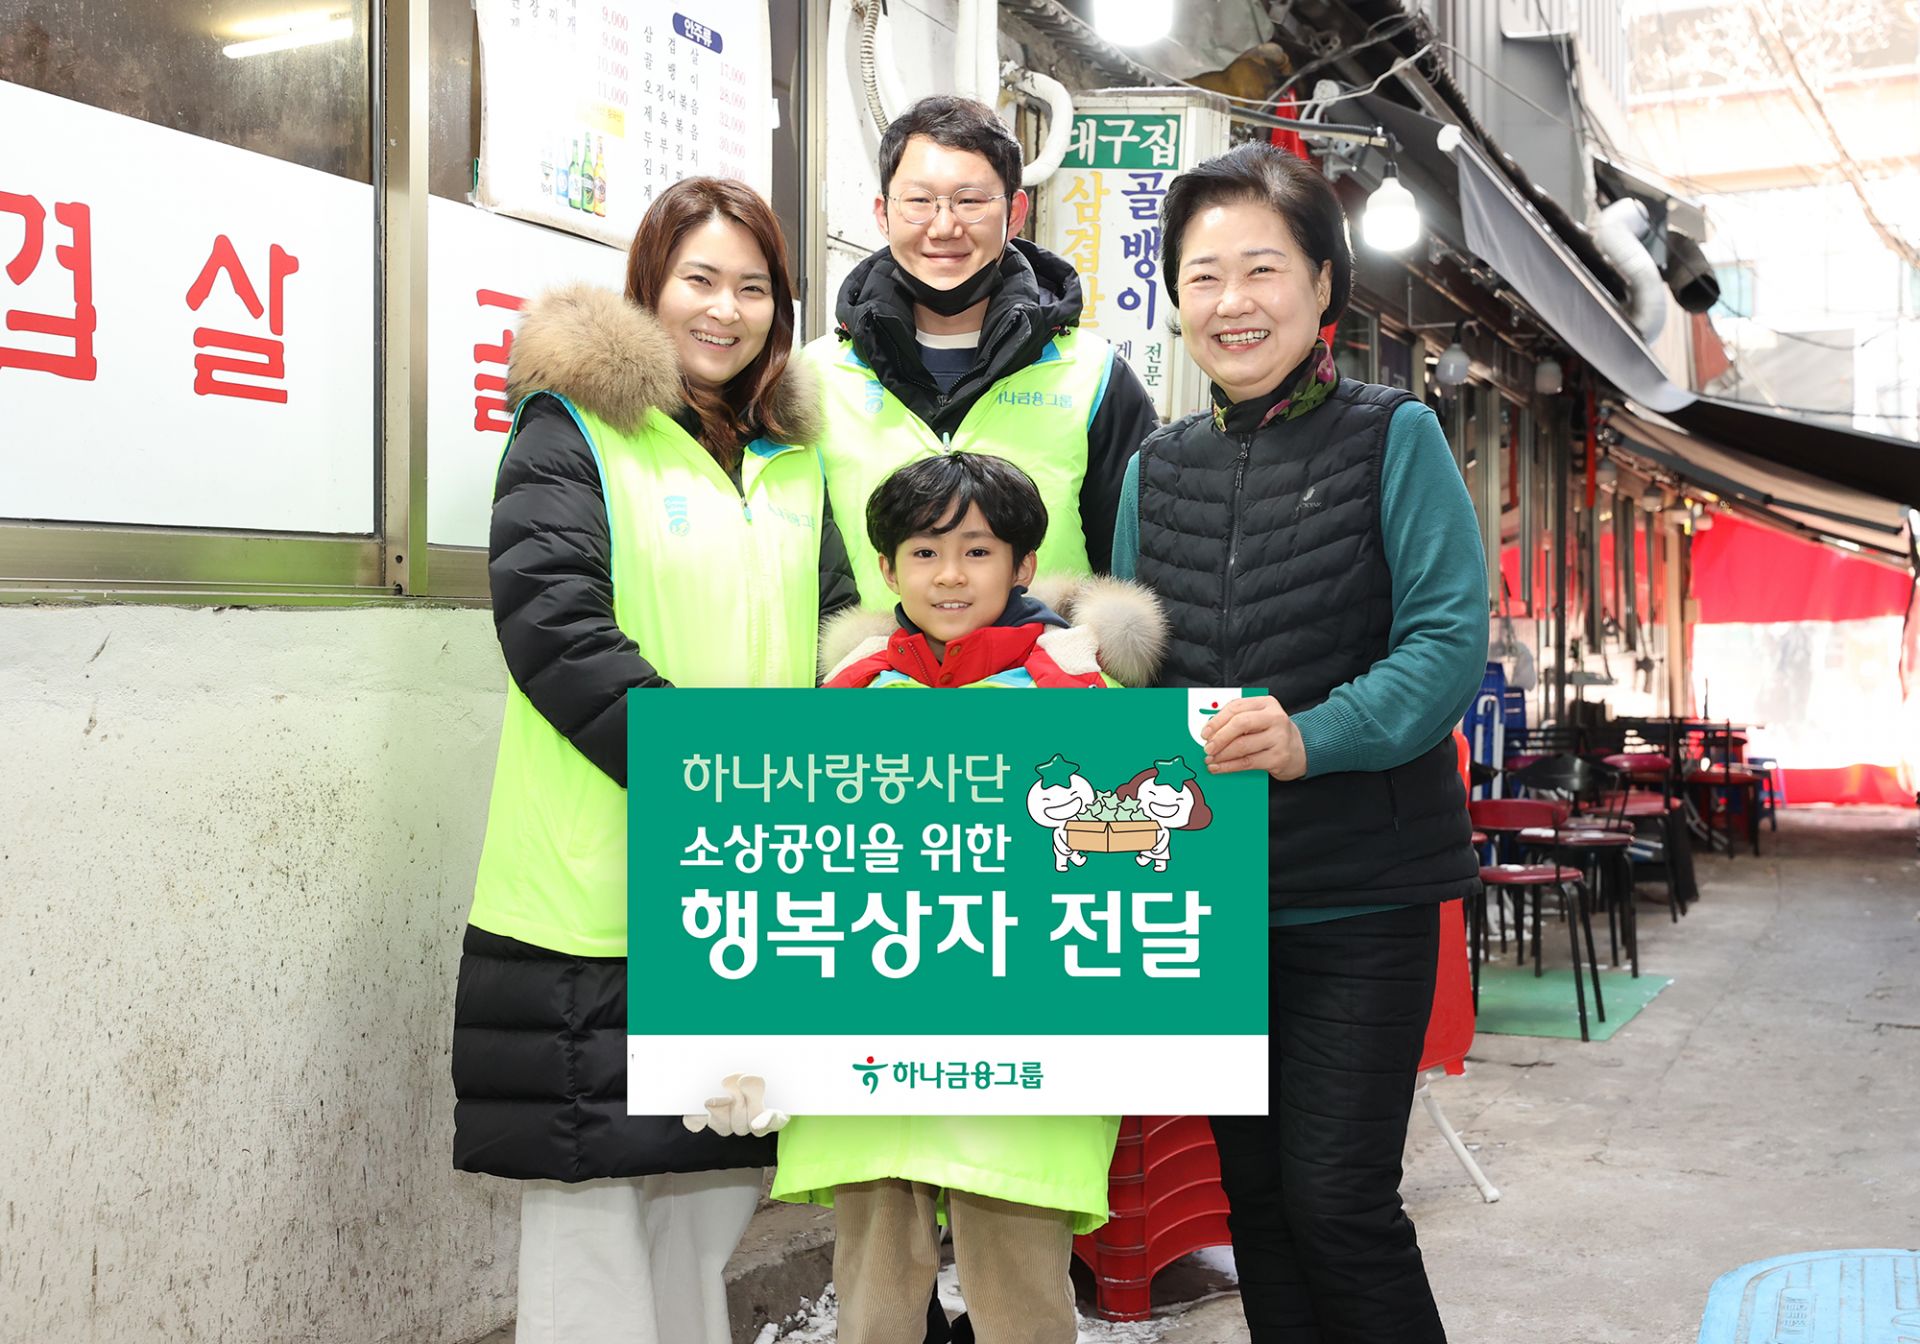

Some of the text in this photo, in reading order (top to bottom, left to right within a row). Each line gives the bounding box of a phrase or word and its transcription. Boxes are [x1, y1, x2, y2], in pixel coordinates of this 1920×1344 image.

[684, 18, 713, 48] 안주류
[1117, 172, 1168, 330] 골뱅이
[1144, 342, 1163, 386] 전문
[682, 753, 1011, 804] 하나사랑봉사단
[680, 823, 1012, 875] 소상공인을 위한
[681, 888, 1212, 980] 행복상자 전달
[892, 1060, 1044, 1090] 하나금융그룹
